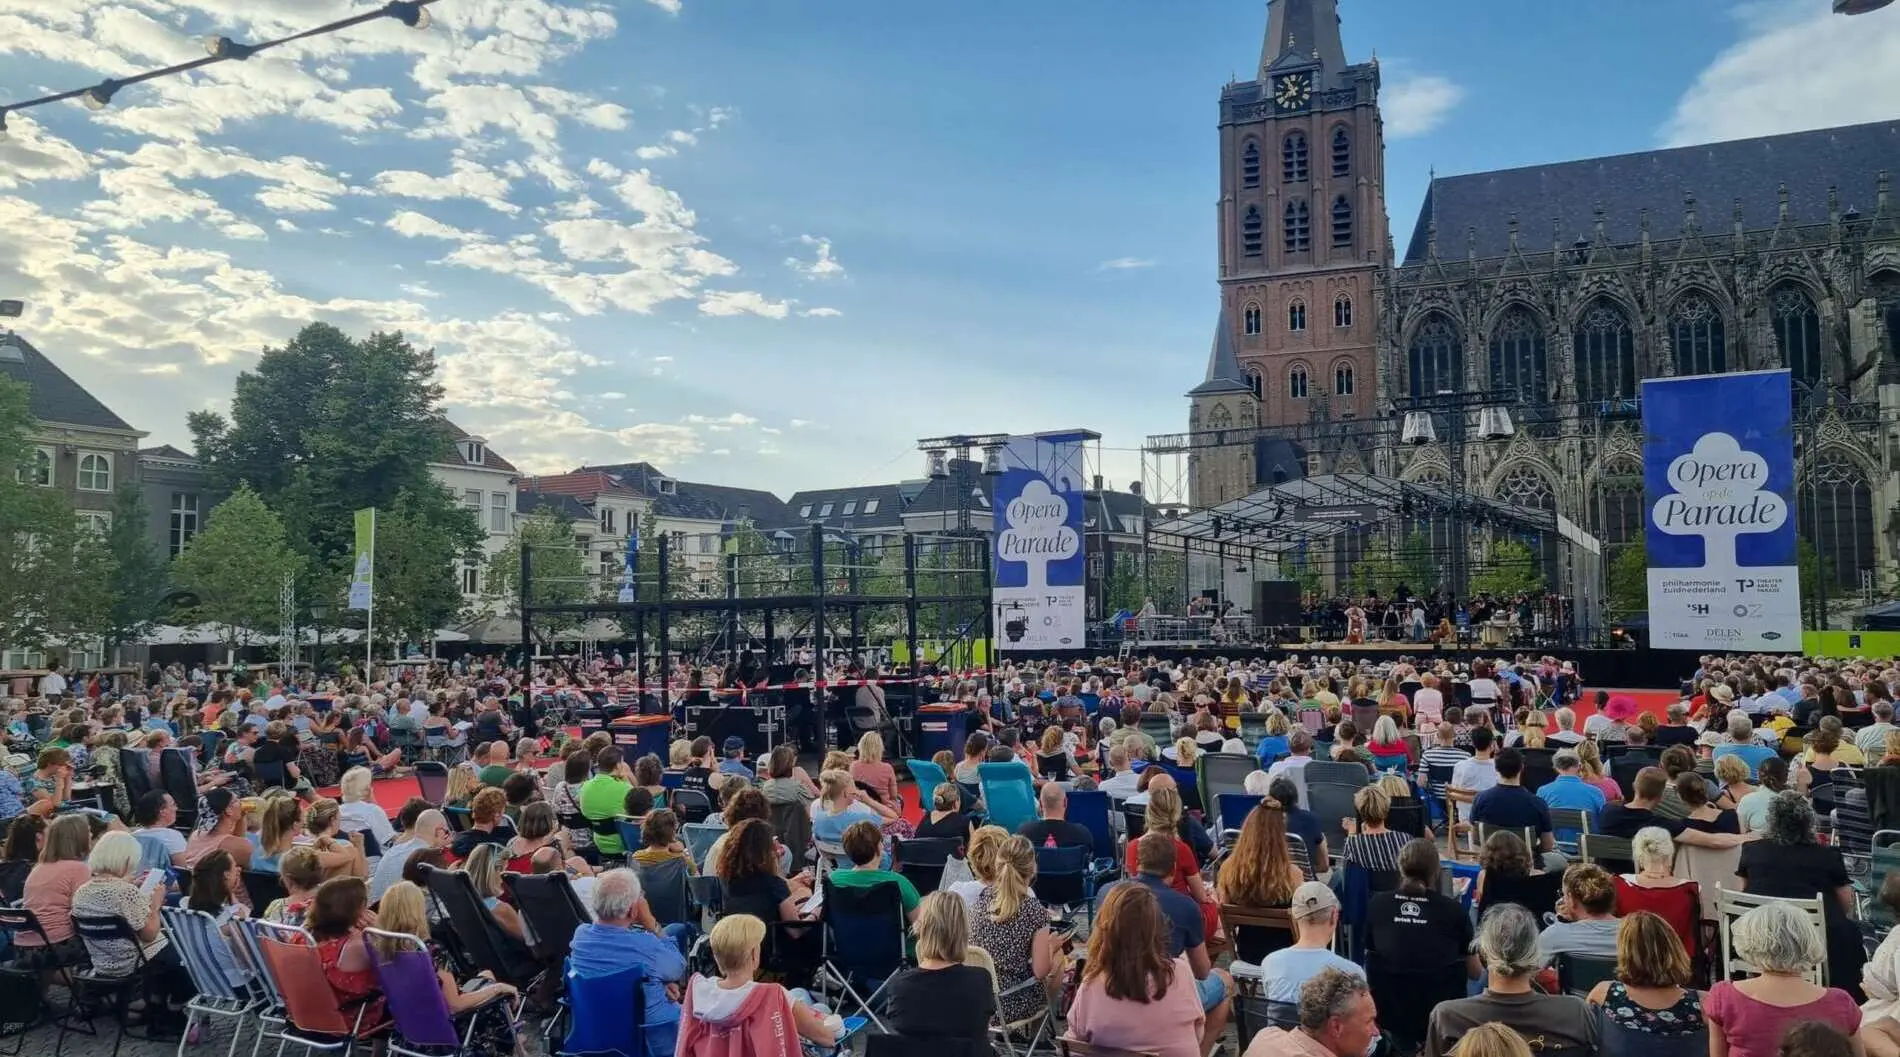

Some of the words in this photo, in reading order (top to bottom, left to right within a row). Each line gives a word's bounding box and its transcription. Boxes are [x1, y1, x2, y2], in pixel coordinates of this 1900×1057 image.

[1677, 459, 1757, 488] Opera
[1012, 501, 1061, 525] Opera
[1664, 495, 1776, 527] Parade
[1004, 530, 1073, 555] Parade
[1662, 579, 1721, 588] philharmonie
[1706, 628, 1742, 637] DELEN
